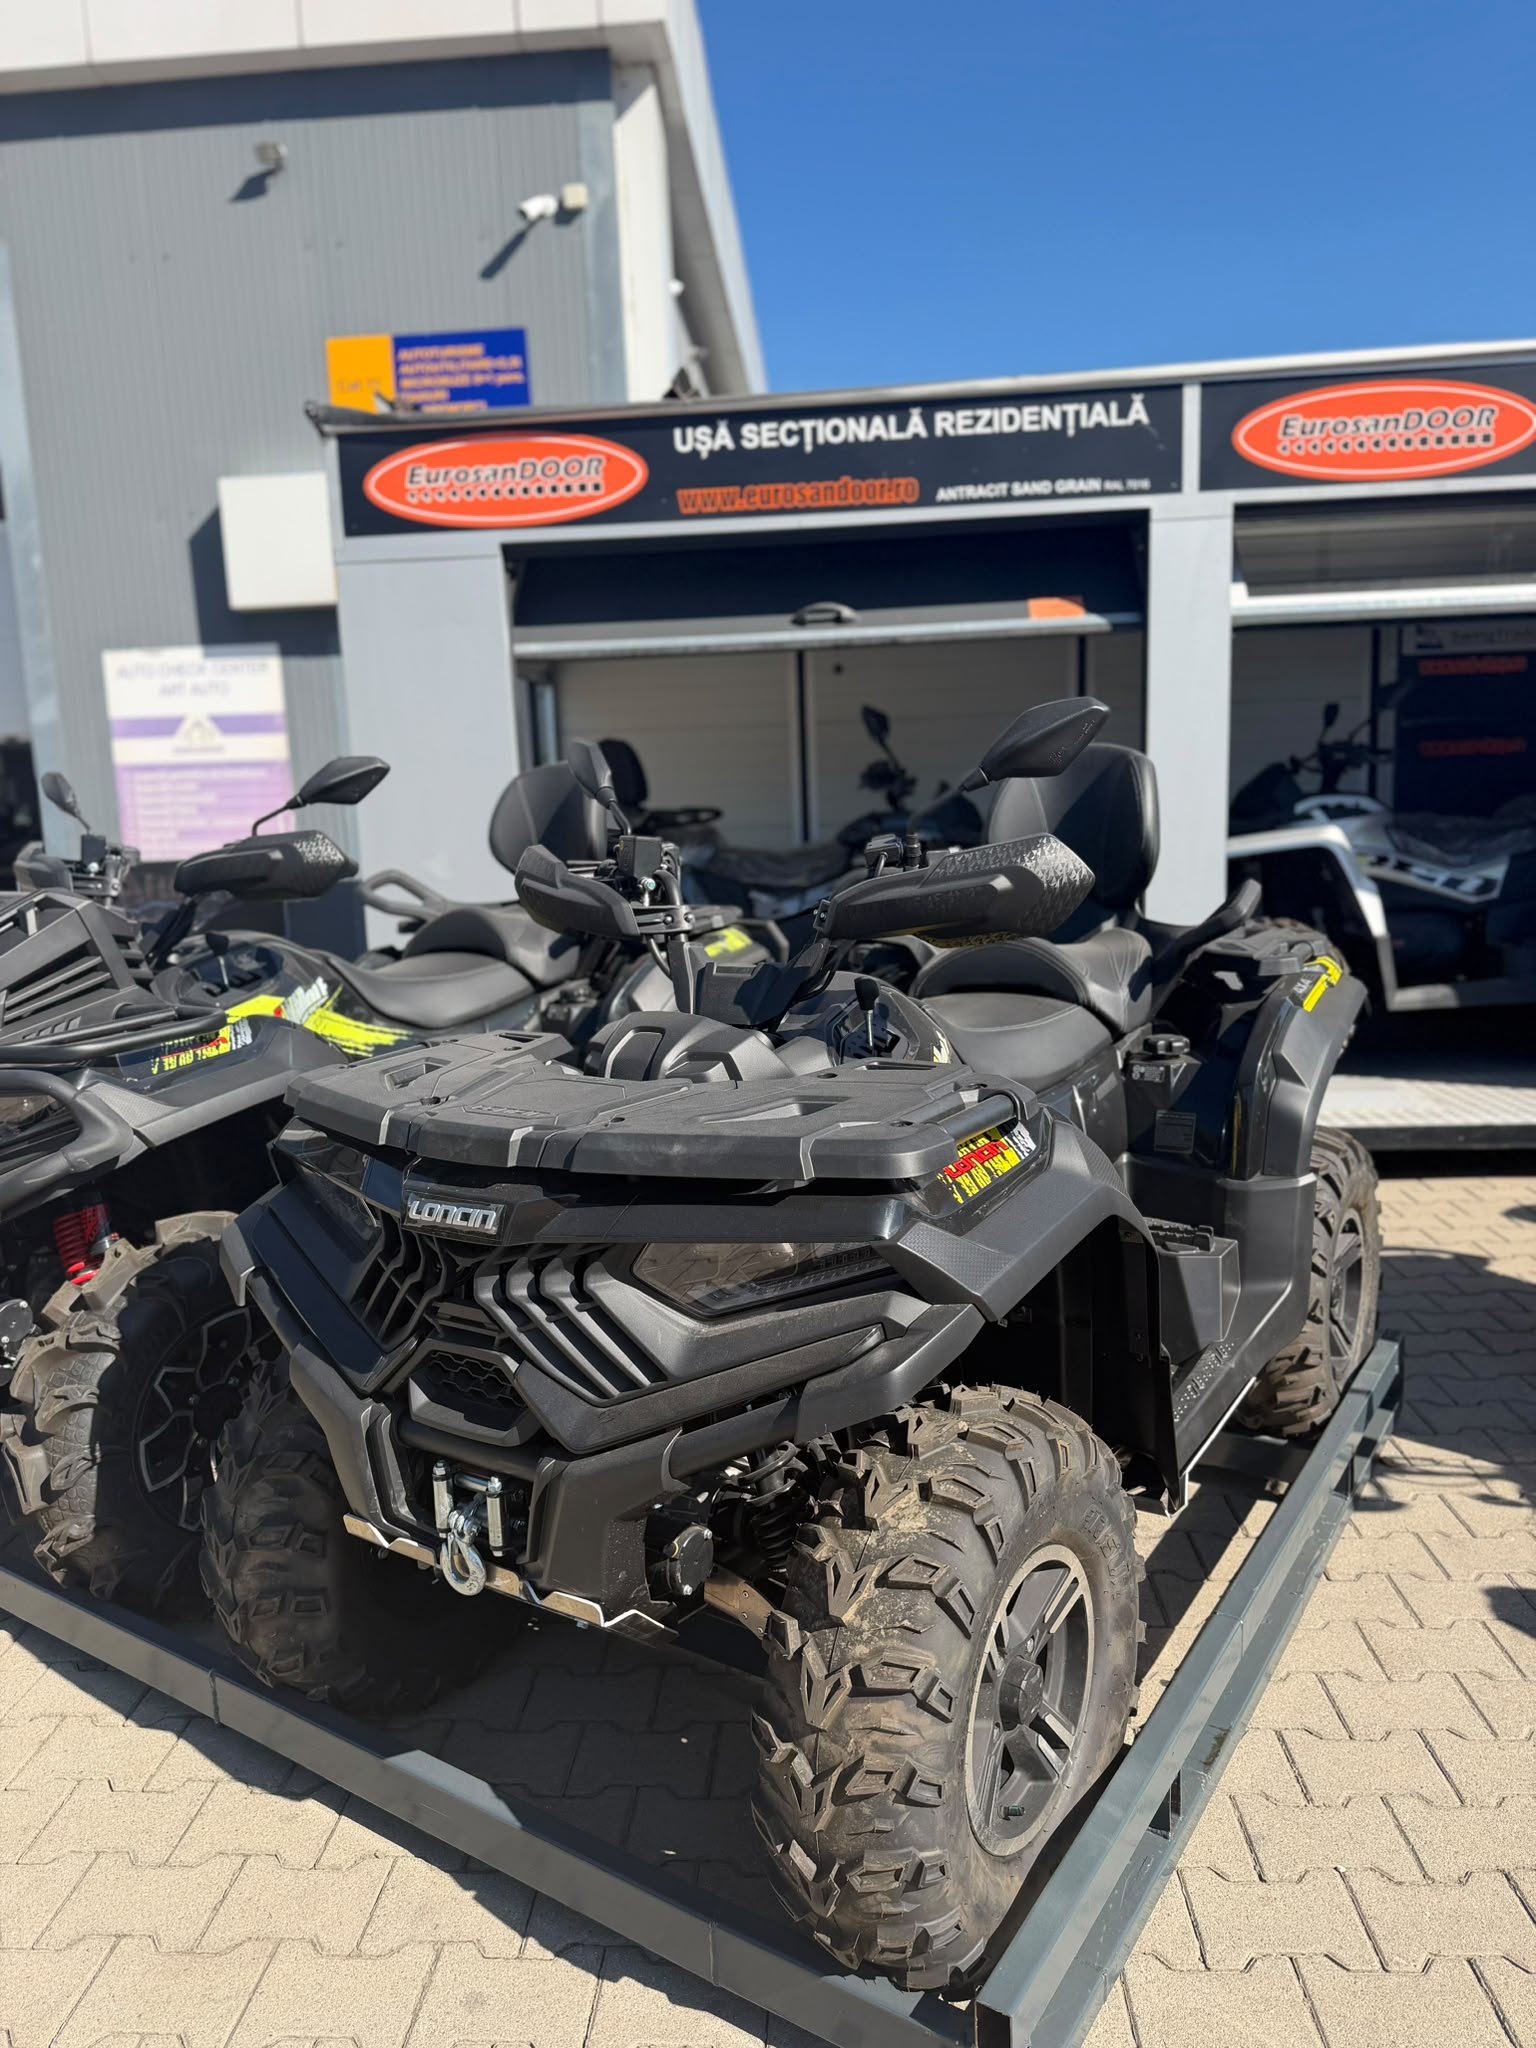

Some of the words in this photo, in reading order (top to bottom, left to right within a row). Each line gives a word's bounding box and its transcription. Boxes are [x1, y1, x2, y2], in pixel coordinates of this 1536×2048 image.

[1280, 405, 1498, 438] EurosanDOOR
[406, 455, 605, 487] EurosanDOOR
[676, 475, 920, 515] www.eurosandoor.ro
[935, 482, 1009, 502] ANTRACIT
[1010, 479, 1052, 497] SAND
[1054, 477, 1102, 495] GRAIN
[408, 1200, 497, 1230] LONCIN
